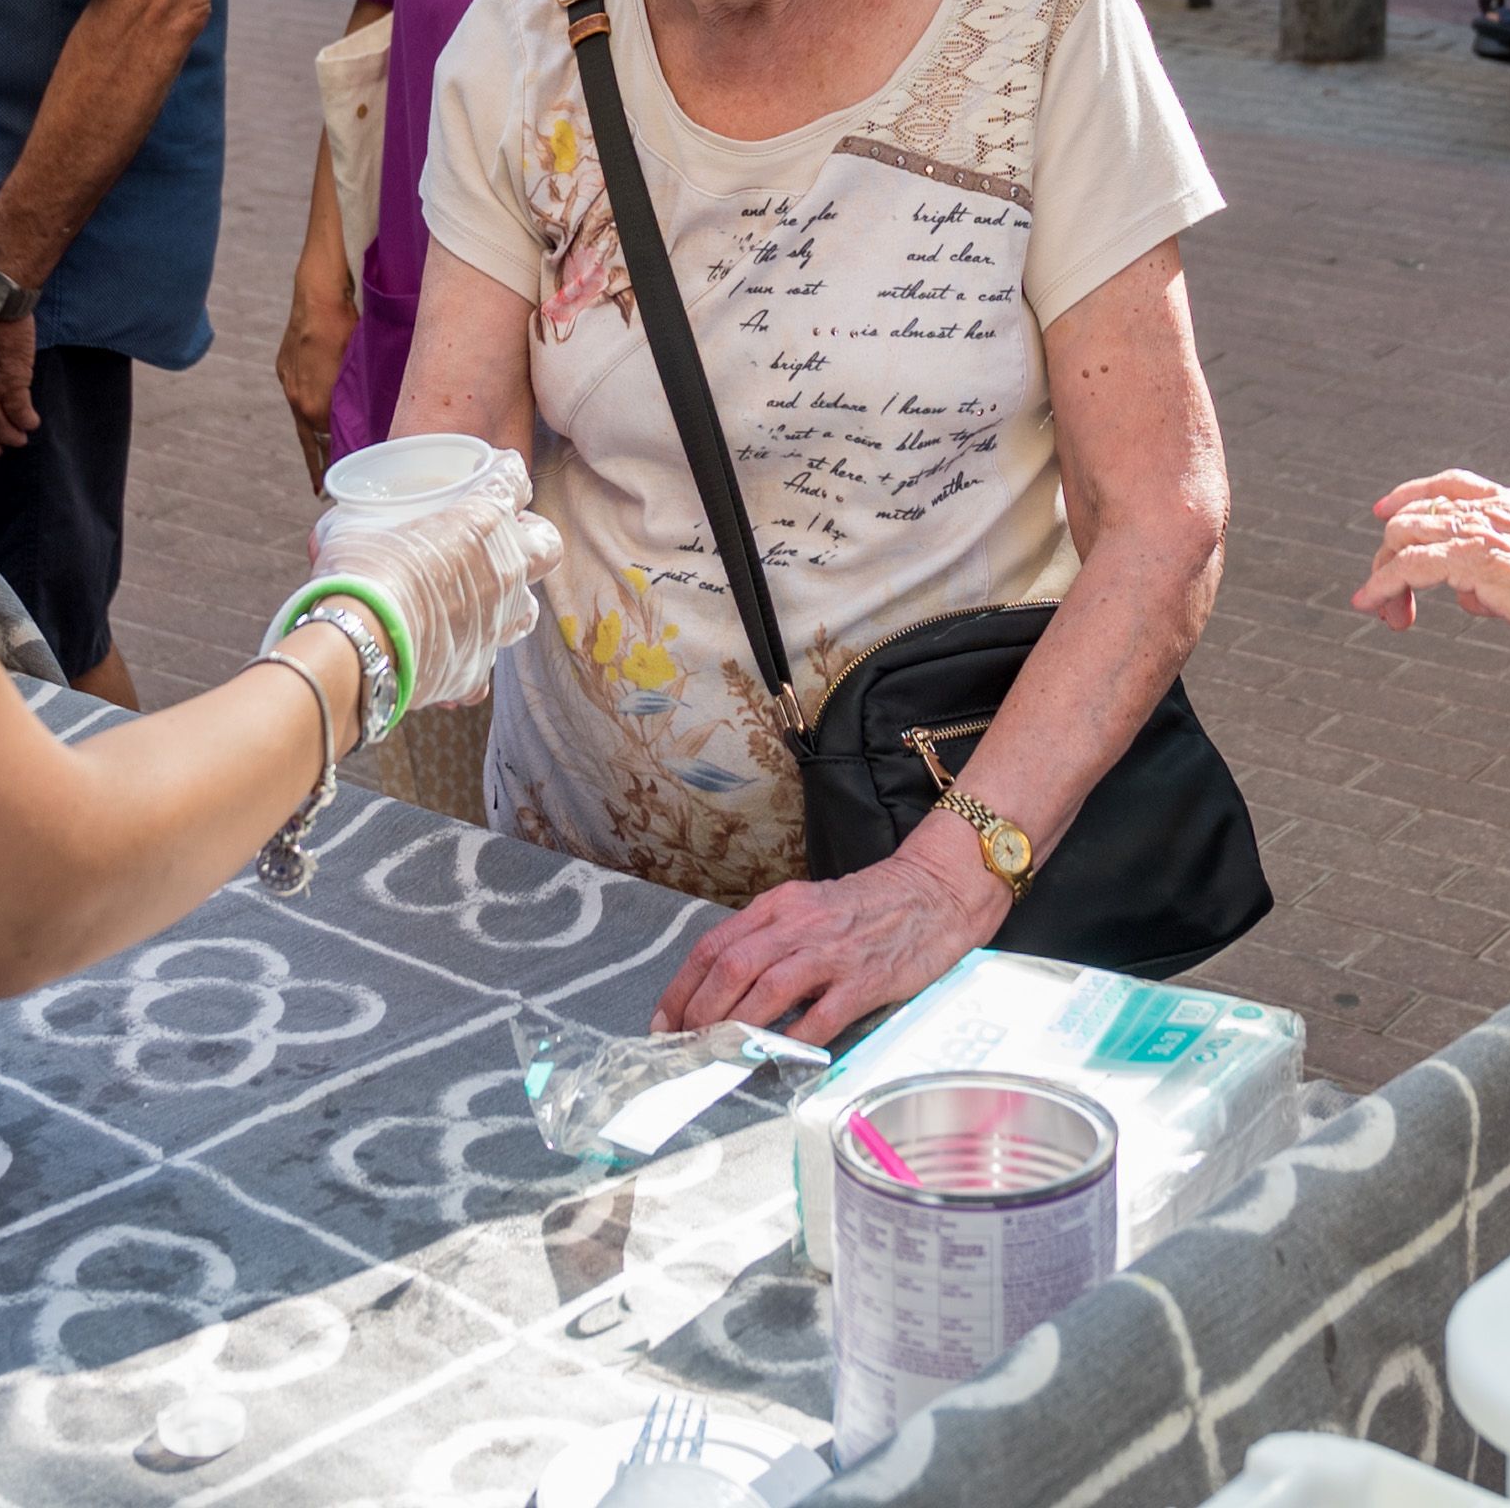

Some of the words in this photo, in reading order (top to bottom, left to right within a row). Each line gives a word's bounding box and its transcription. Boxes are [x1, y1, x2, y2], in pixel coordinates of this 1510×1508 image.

[741, 196, 772, 217] and
[912, 202, 973, 235] bright
[974, 208, 1010, 226] and
[787, 238, 816, 270] sky
[906, 244, 943, 263] and
[877, 279, 955, 300] without
[956, 292, 967, 301] a
[890, 317, 963, 339] almost
[769, 351, 831, 382] bright
[766, 391, 803, 409] and
[898, 395, 948, 415] know
[651, 569, 700, 586] just
